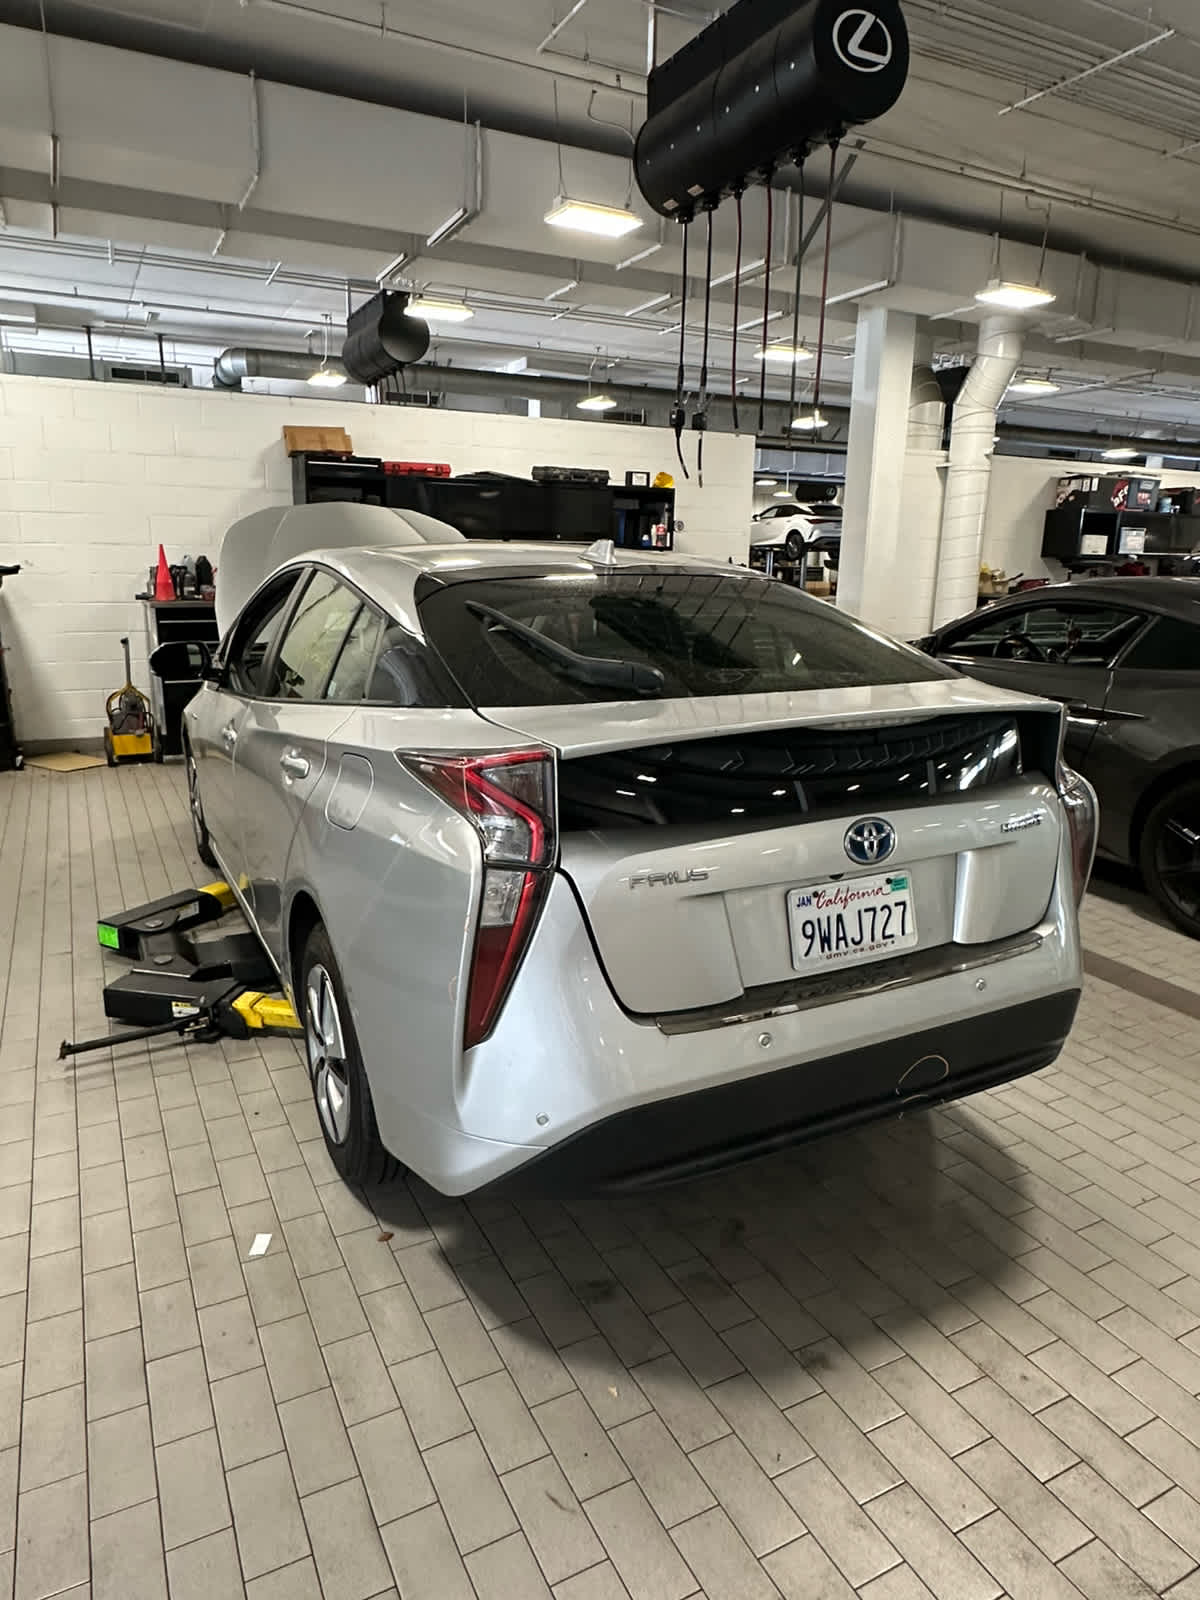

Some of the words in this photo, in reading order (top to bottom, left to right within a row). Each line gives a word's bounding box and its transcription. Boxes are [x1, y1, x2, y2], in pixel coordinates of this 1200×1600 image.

[796, 895, 812, 908] JAN
[815, 885, 890, 910] California
[801, 900, 907, 958] 9WAJ727
